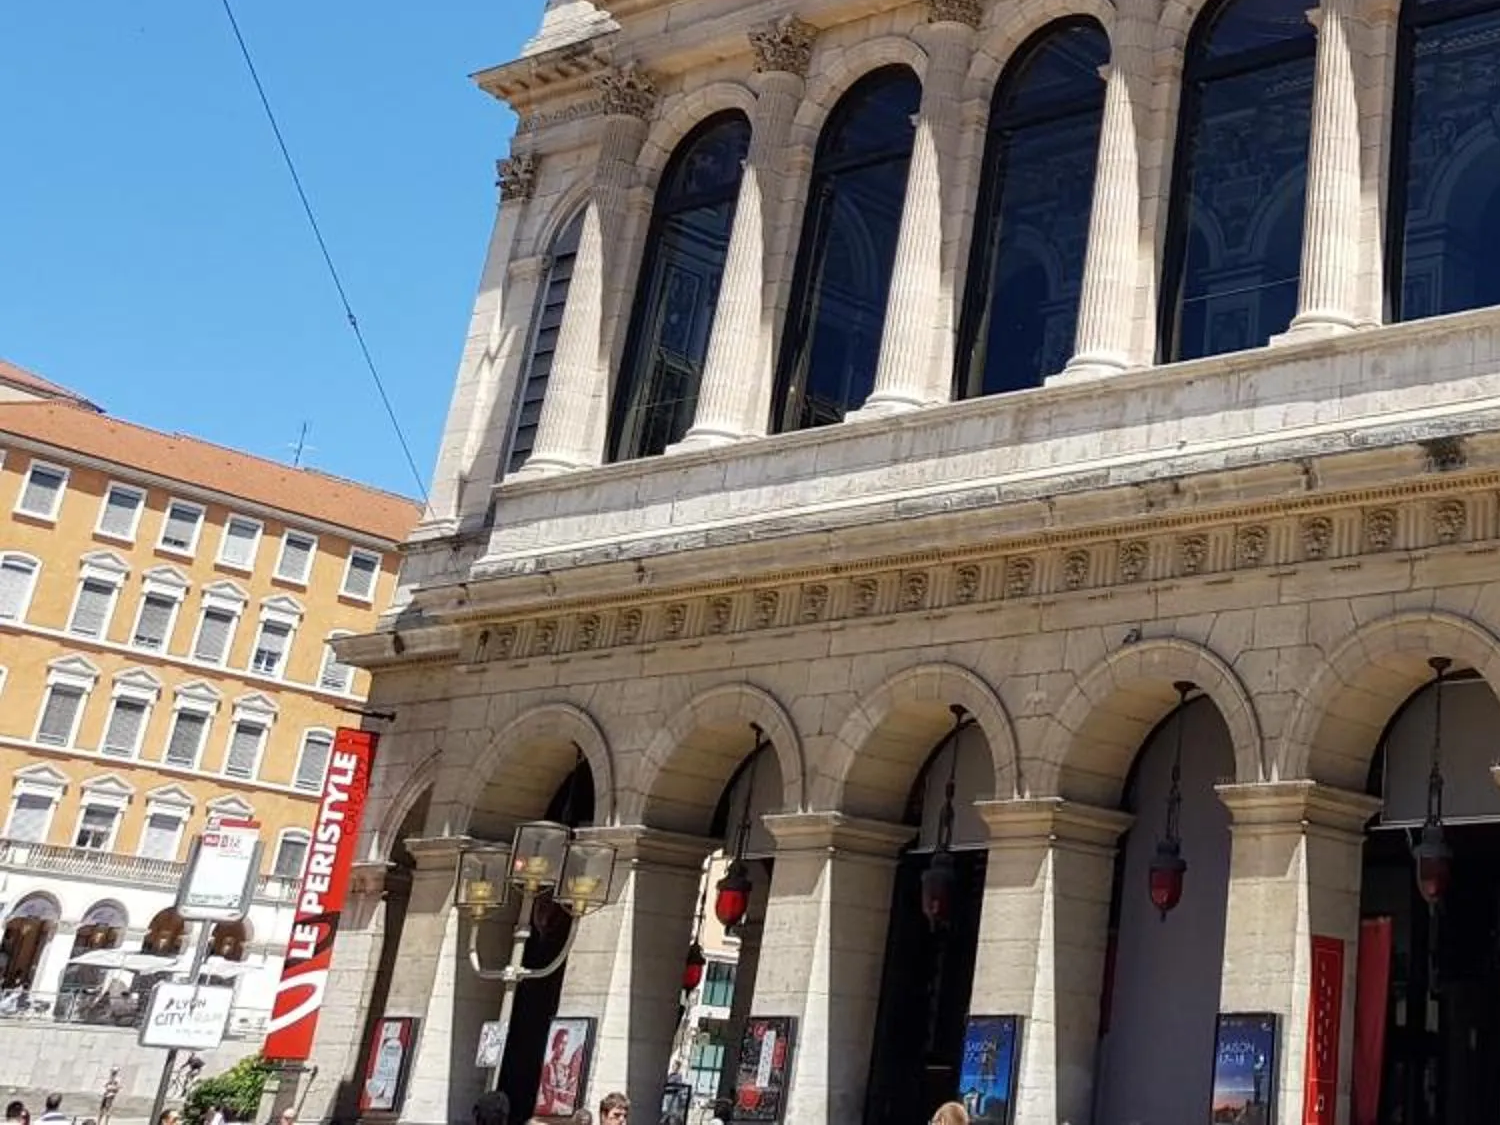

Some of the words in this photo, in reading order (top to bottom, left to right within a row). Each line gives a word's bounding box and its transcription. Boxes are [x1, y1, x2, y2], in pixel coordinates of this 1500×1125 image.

[301, 750, 358, 915] PERISTYLE
[289, 921, 319, 960] LE
[155, 1012, 186, 1026] CITY
